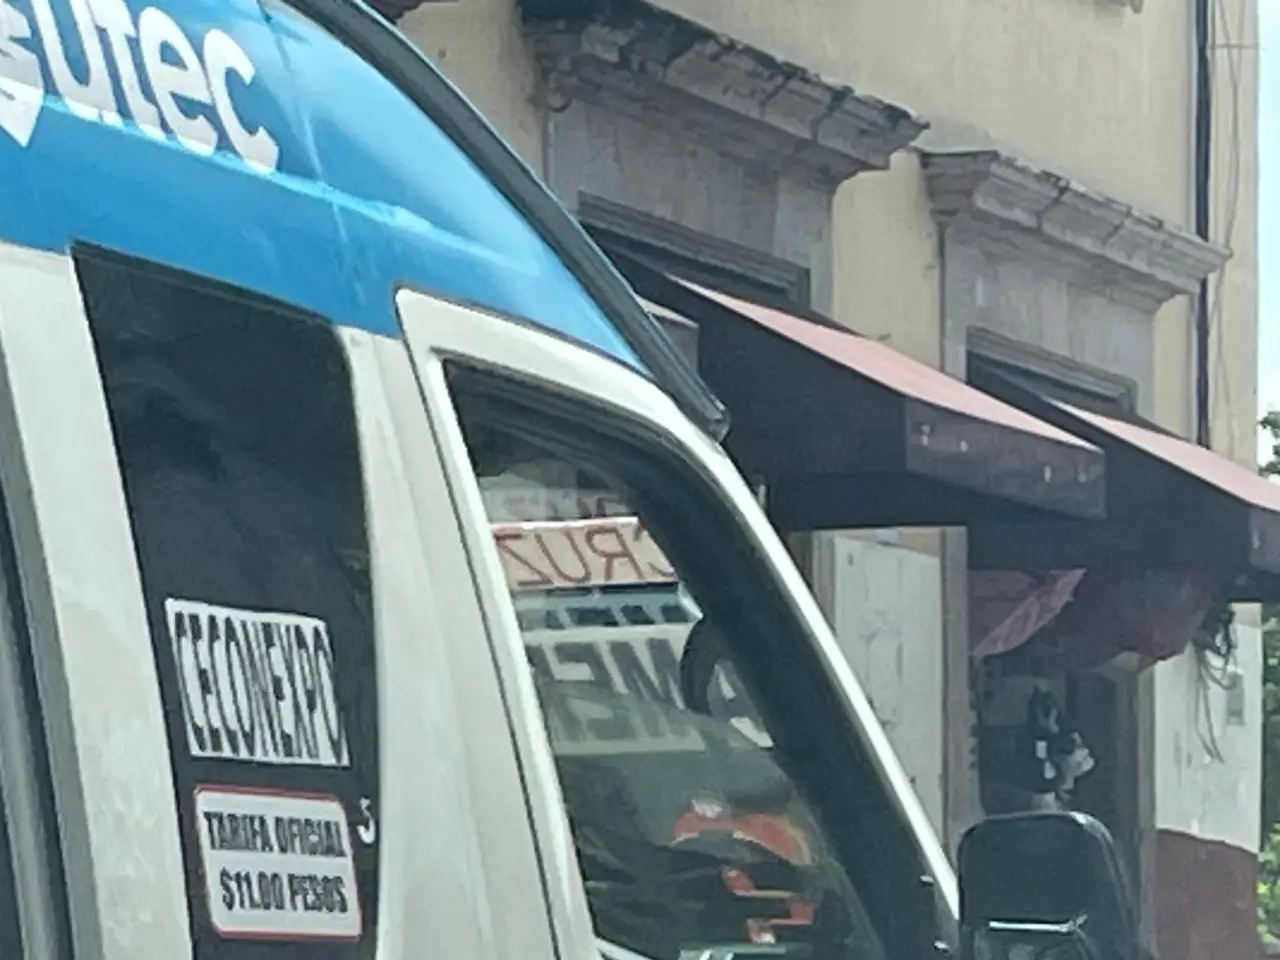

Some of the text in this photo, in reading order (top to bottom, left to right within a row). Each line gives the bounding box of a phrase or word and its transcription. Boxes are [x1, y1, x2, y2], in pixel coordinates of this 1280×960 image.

[172, 609, 348, 764] CECONEXPO
[203, 811, 273, 852] TARIFA
[274, 816, 347, 857] OFICIAL
[220, 866, 349, 913] $11.00 PESOS
